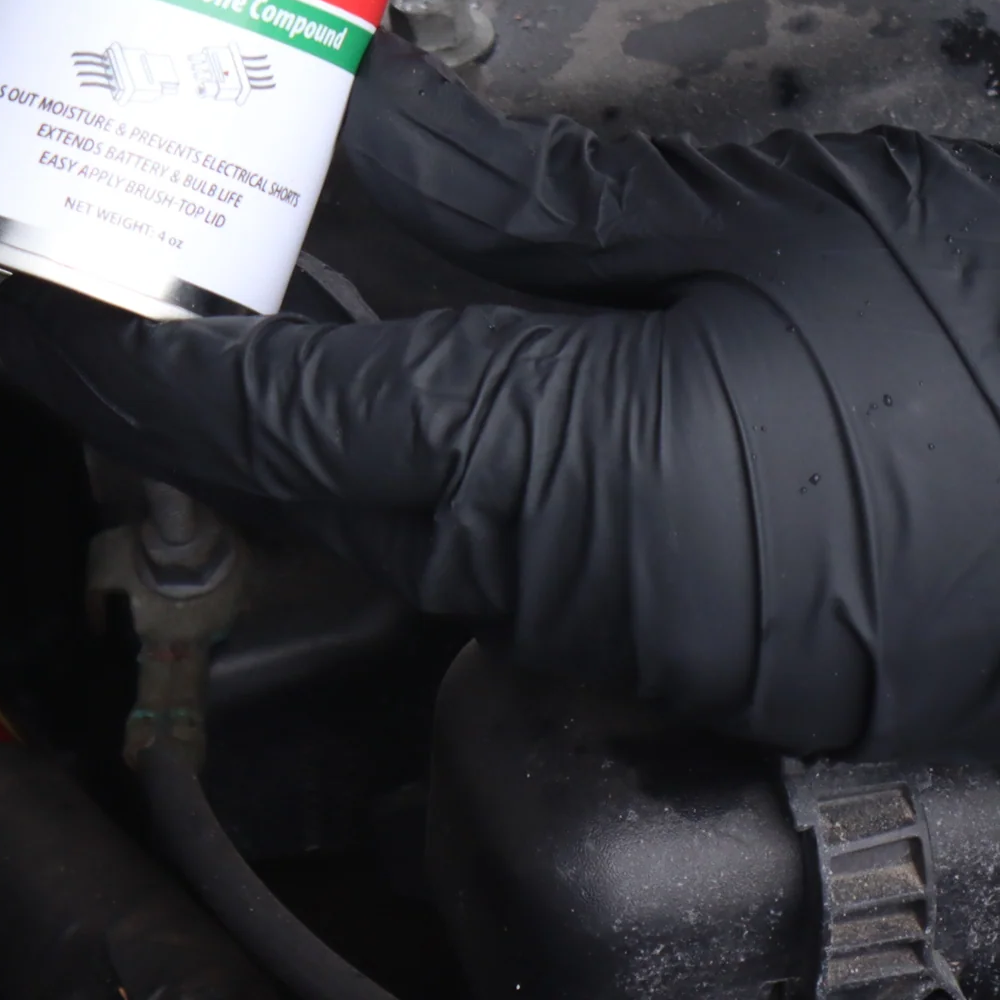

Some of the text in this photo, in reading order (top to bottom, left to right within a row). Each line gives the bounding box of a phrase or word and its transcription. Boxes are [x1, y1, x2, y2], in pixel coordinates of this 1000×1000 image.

[7, 87, 39, 107] OUT
[38, 96, 115, 132] MOISTURE
[115, 122, 127, 137] &
[128, 126, 204, 164] PREVENTS
[201, 153, 269, 193] ELECTRICAL
[267, 181, 301, 209] SHORTS
[36, 122, 244, 209] EXTENDS BATTERY & BULB LIFE
[38, 150, 227, 229] EASY APPLY BRUSH-TOP LID
[64, 196, 93, 216] NET
[157, 230, 167, 242] 4
[168, 236, 185, 249] oz
